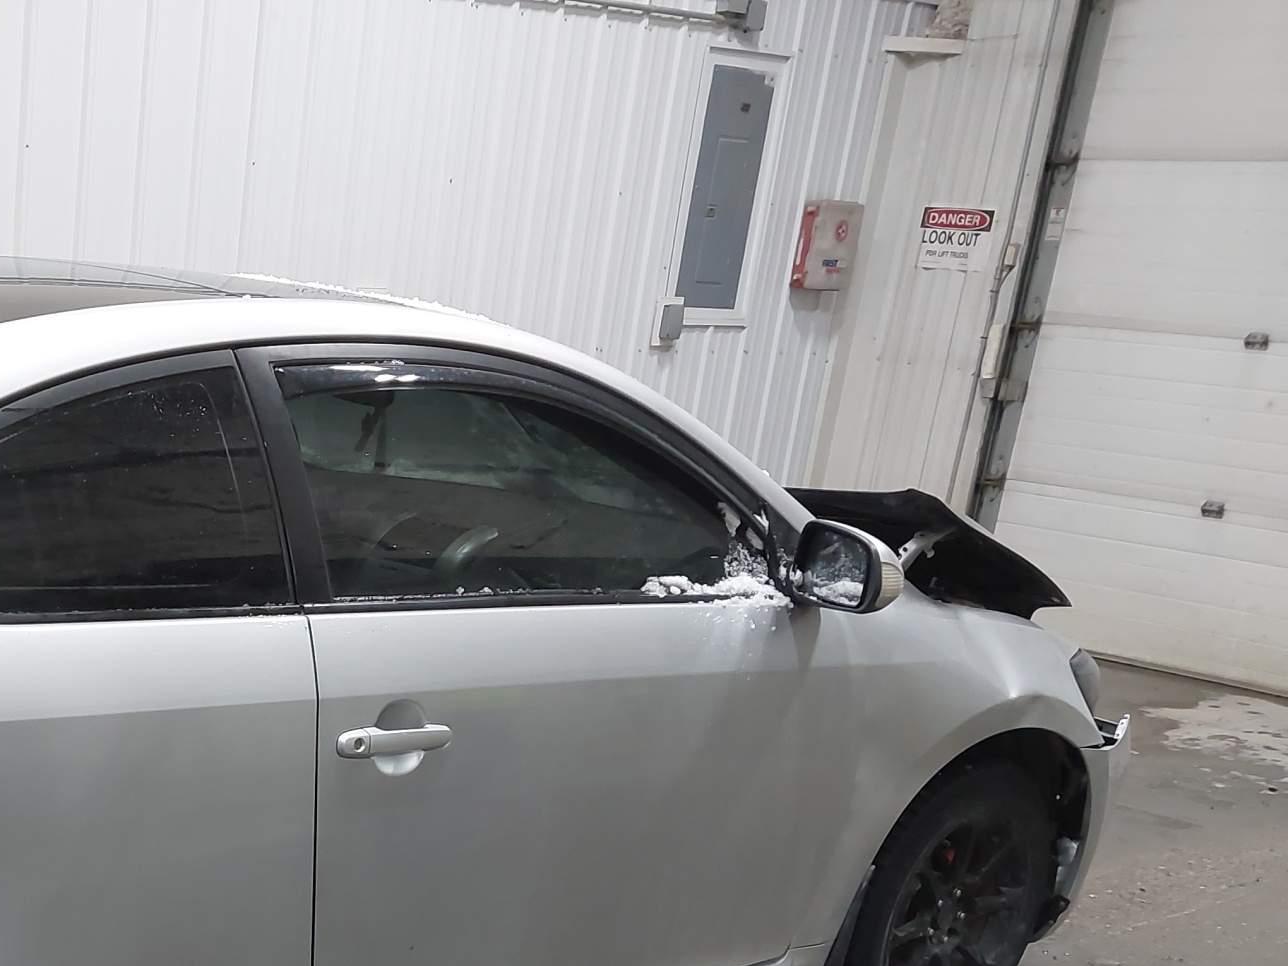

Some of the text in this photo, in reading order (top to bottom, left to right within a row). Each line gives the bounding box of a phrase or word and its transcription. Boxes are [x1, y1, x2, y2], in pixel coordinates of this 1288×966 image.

[929, 213, 981, 226] DANGER
[922, 230, 981, 246] LOOK OUT
